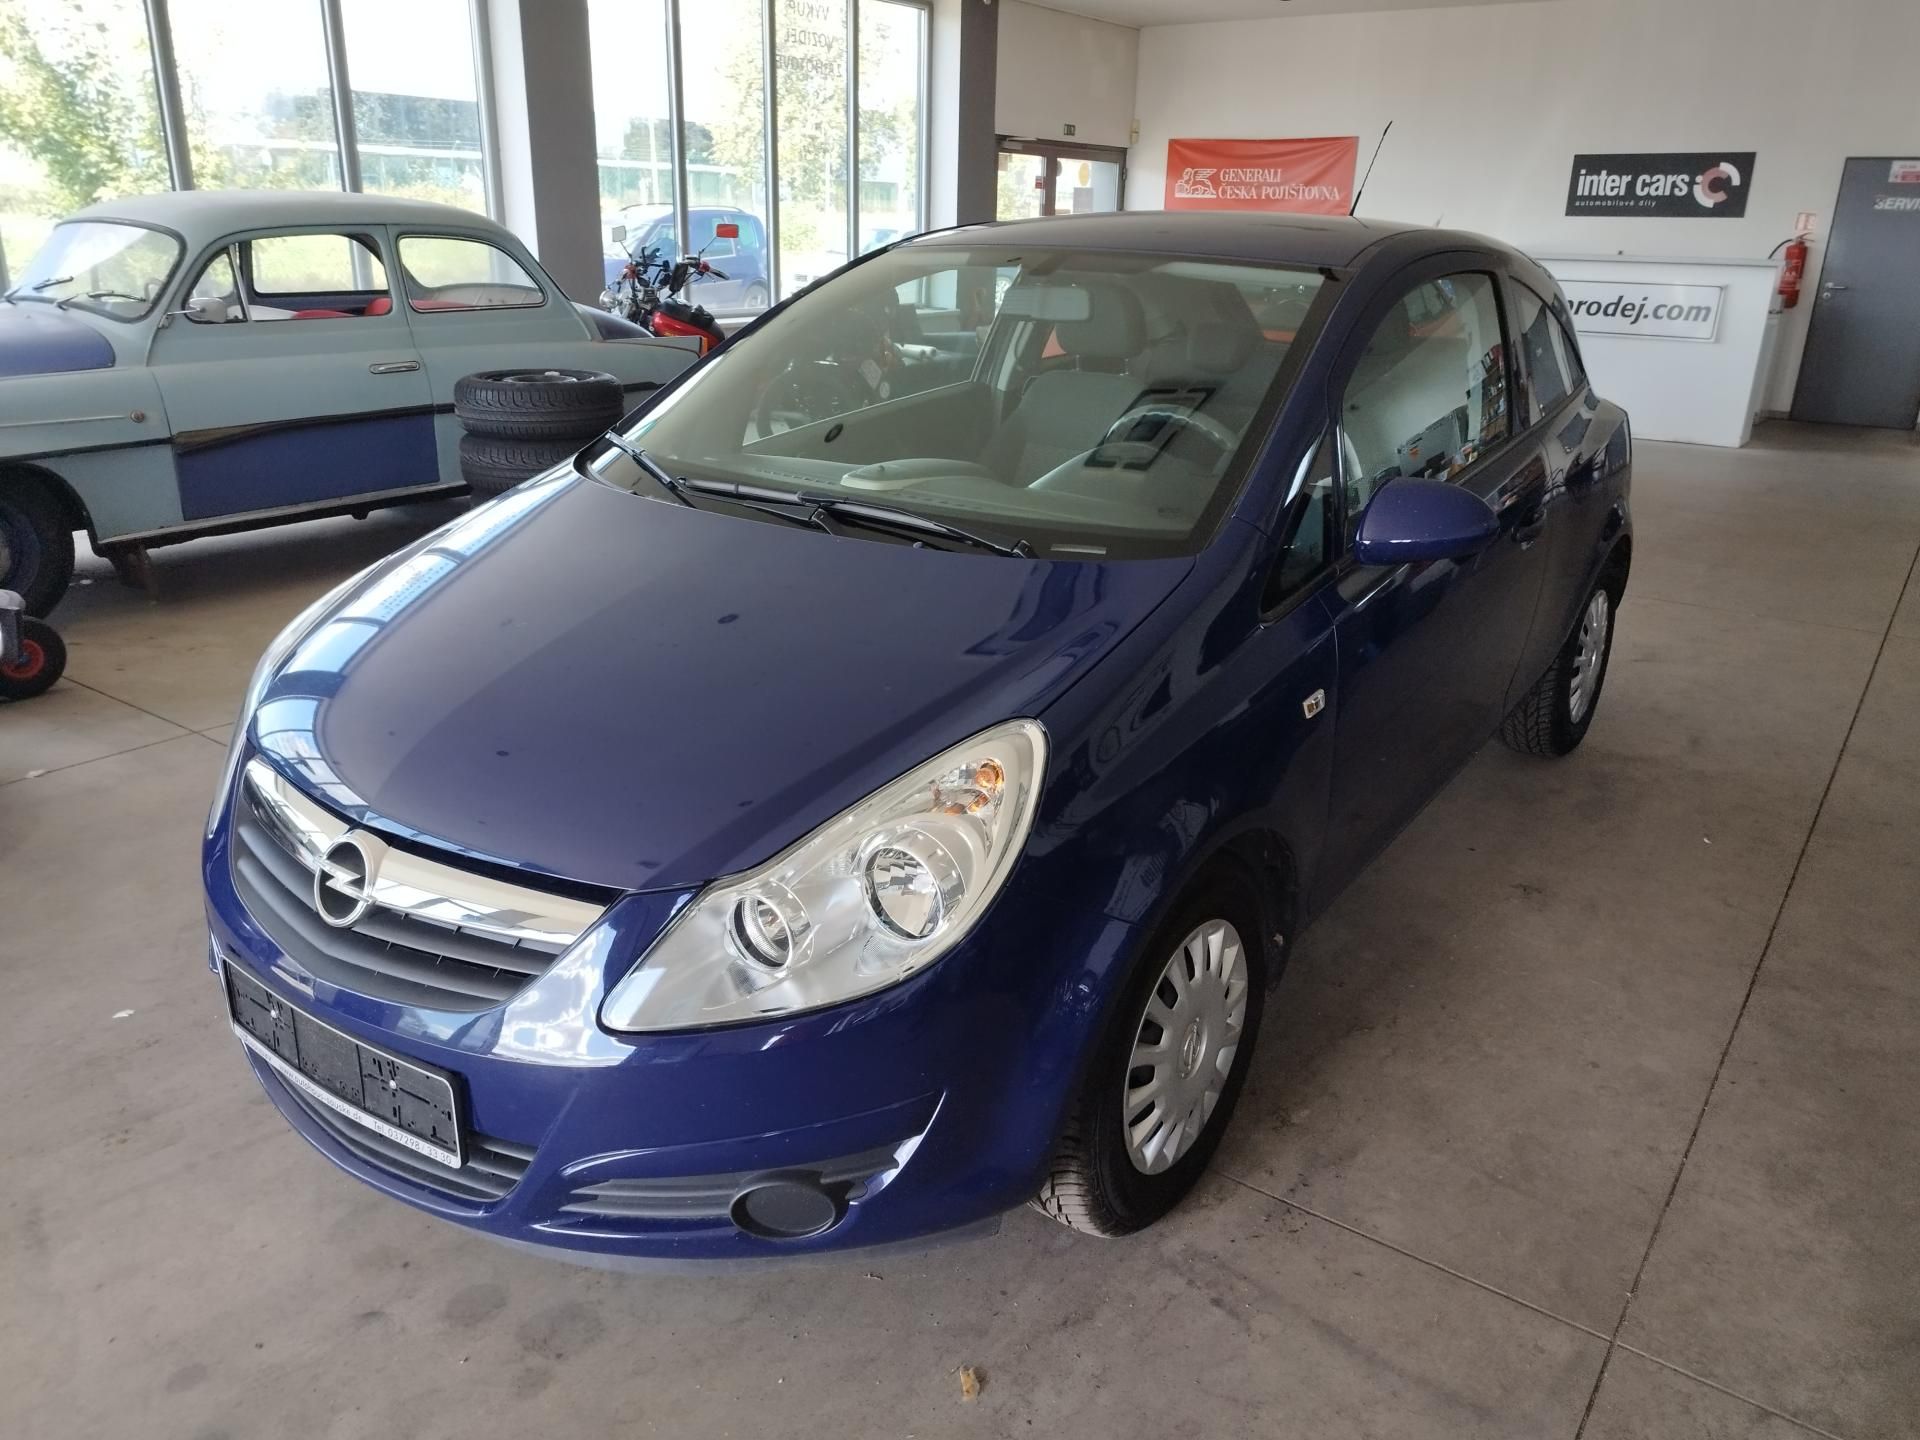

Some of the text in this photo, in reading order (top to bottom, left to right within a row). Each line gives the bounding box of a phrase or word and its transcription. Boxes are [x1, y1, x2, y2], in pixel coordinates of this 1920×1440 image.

[1220, 168, 1282, 183] GENERALI
[1577, 169, 1690, 197] inter cars
[1218, 183, 1340, 200] ČESKÁ POJIŠŤOVNA
[1638, 200, 1657, 208] díly
[1873, 197, 1920, 210] SERVI
